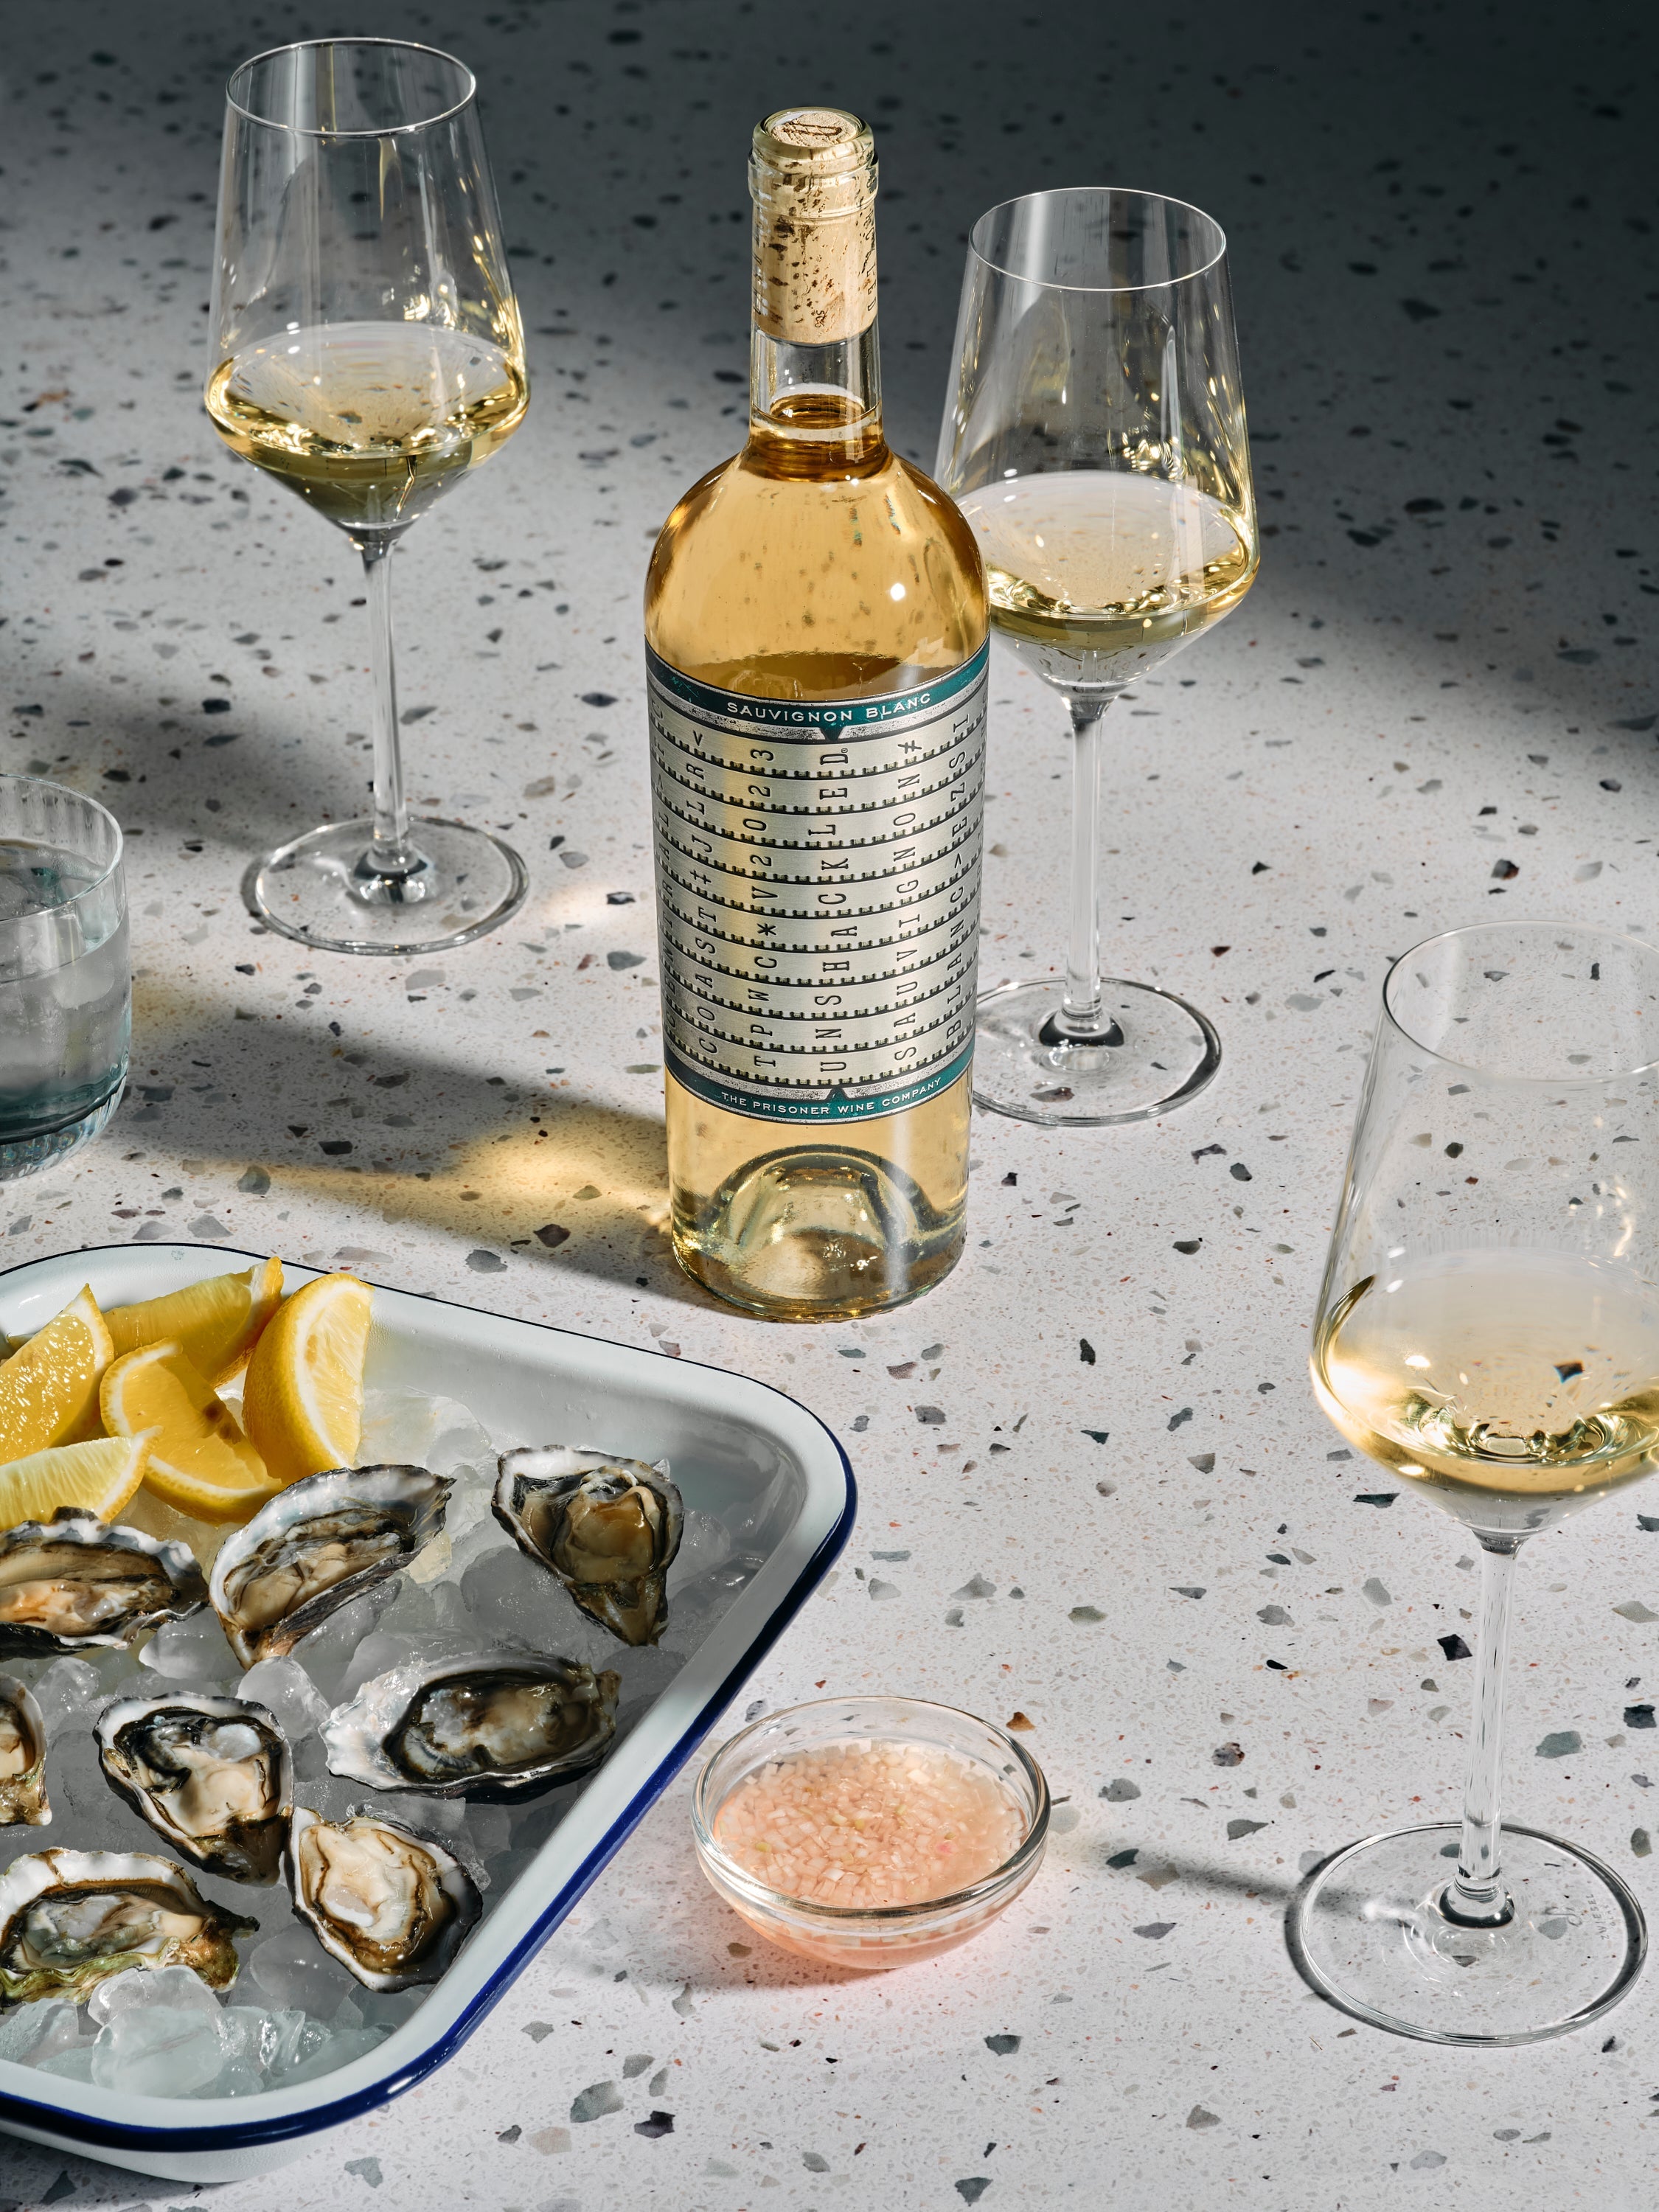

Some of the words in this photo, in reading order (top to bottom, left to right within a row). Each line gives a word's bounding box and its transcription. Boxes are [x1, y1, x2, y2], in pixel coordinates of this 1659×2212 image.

[727, 702, 852, 722] SAUVIGNON
[866, 693, 931, 719] BLANC
[721, 1092, 747, 1107] THE
[753, 1101, 830, 1115] PRISONER
[838, 1102, 875, 1114] WINE
[882, 1077, 942, 1107] COMPANY
[1586, 1893, 1610, 1941] ZWIESEL
